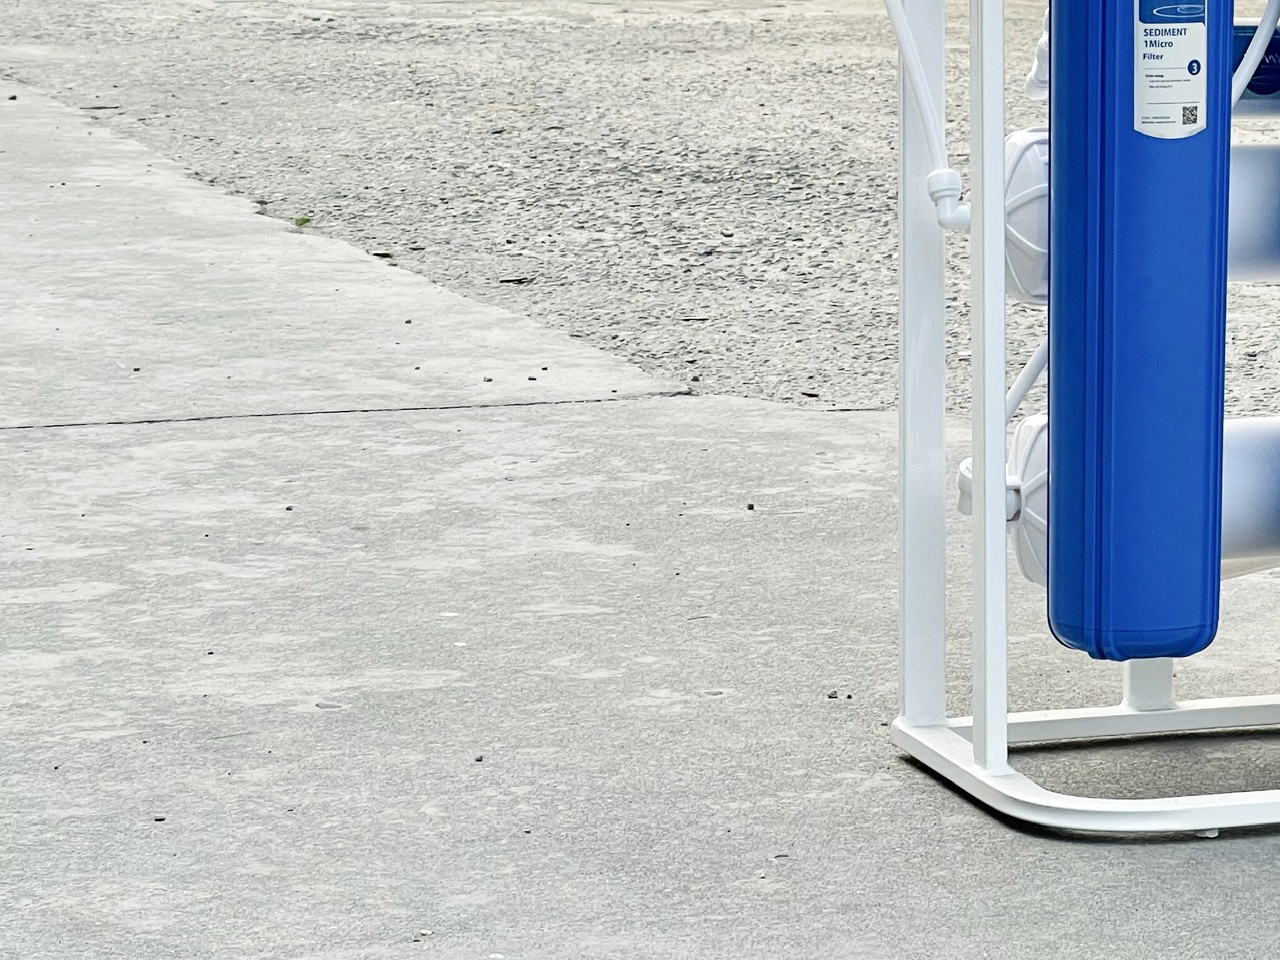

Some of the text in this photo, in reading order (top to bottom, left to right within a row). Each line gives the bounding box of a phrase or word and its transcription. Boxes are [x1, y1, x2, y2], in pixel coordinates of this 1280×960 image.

[1143, 28, 1188, 37] SEDIMENT
[1144, 40, 1174, 48] 1Micro
[1192, 62, 1198, 74] 3
